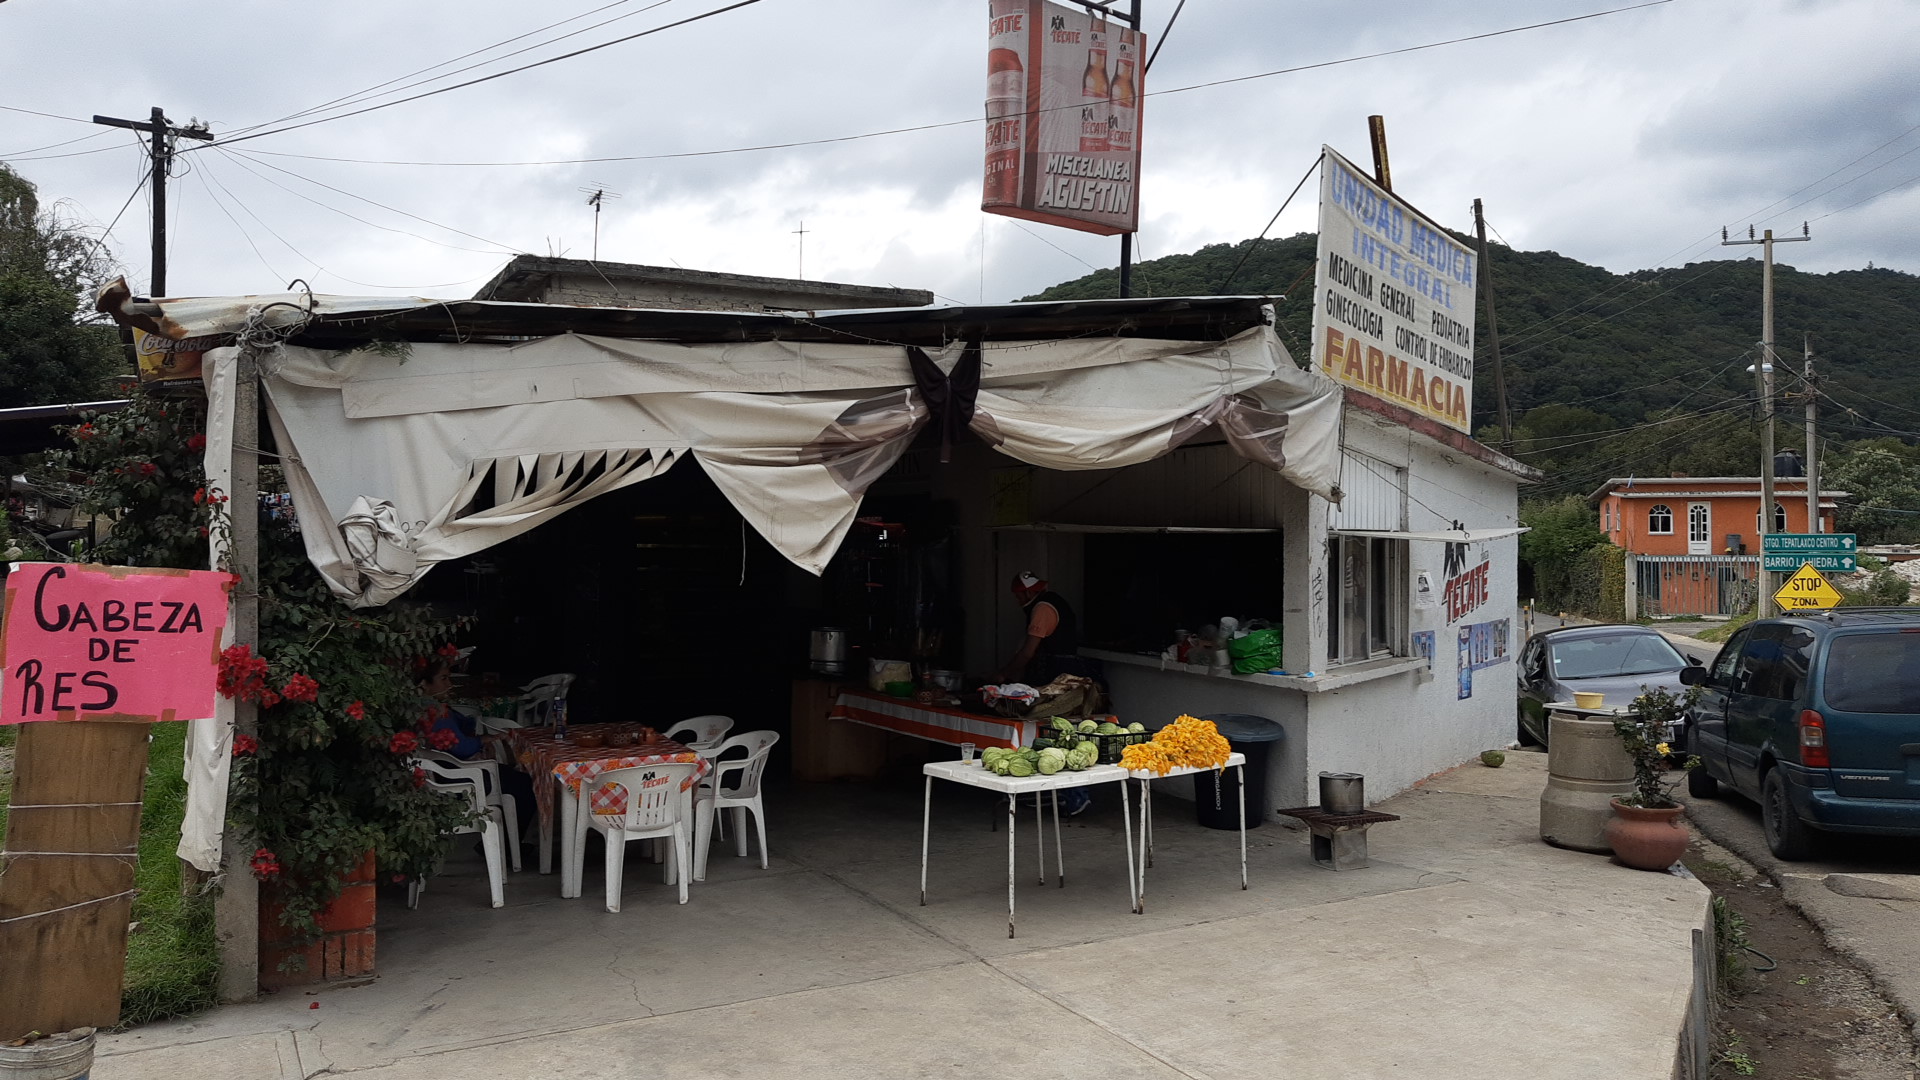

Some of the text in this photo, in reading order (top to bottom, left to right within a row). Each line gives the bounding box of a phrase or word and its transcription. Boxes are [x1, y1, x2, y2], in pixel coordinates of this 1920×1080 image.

[1052, 30, 1081, 44] TECATE
[1081, 121, 1107, 135] TECATE
[1045, 153, 1131, 182] MISCELANEA
[1038, 175, 1132, 214] AGUSTIN
[1332, 161, 1472, 288] UNIDAD MEDICA
[1352, 227, 1454, 310] INTEGRAL
[1329, 251, 1470, 349] MEDICINA GENERAL PEDIATRIA
[1326, 289, 1471, 380] GINECOLOGIA CONTROL DE EMBARAZO
[1323, 326, 1468, 427] FARMACIA
[1765, 538, 1838, 548] STGO. TEPATLAXCO CENTRO
[1765, 557, 1838, 568] BARRIO LA HIEDRA
[34, 566, 203, 633] CABEZA
[1441, 560, 1490, 626] TECATE
[1792, 578, 1822, 591] STOP
[1791, 598, 1819, 606] ZONA
[88, 637, 139, 662] DE
[15, 658, 118, 716] RES
[641, 776, 670, 788] TECATE
